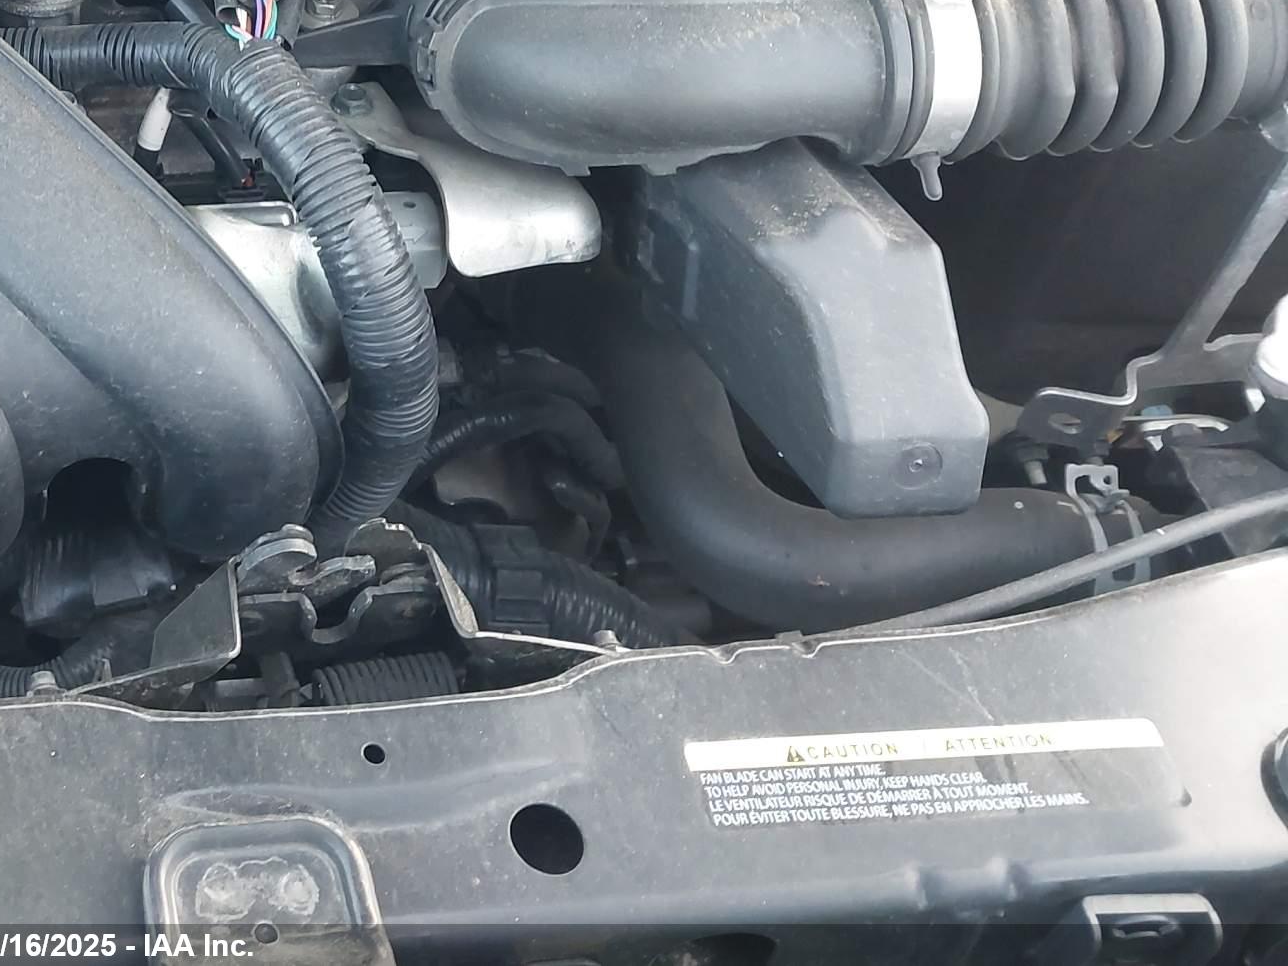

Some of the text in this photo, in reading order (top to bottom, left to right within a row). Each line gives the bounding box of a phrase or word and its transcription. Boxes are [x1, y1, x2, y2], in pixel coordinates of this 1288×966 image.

[806, 733, 1054, 760] CAUTION ATTENTION
[700, 763, 886, 785] FAN BLADE CAN START AT ANY TIME.
[704, 785, 722, 799] TO
[721, 784, 750, 798] HELP
[751, 782, 786, 796] AVOID
[785, 780, 843, 794] PERSONAL
[882, 775, 909, 789] KEEP
[909, 773, 950, 787] HANDS
[709, 800, 724, 813] LE
[723, 795, 804, 812] VENTILATEUR
[803, 792, 848, 807] RISQUE
[847, 791, 867, 806] DE
[866, 788, 932, 804] DÉMARRER
[941, 785, 974, 799] TOUT
[974, 782, 1033, 797] MOMENT.
[713, 791, 1090, 827] POUR ÉVITER TOUTE BLESSURE, NE PAS EN APPROCHER LES MAINS.
